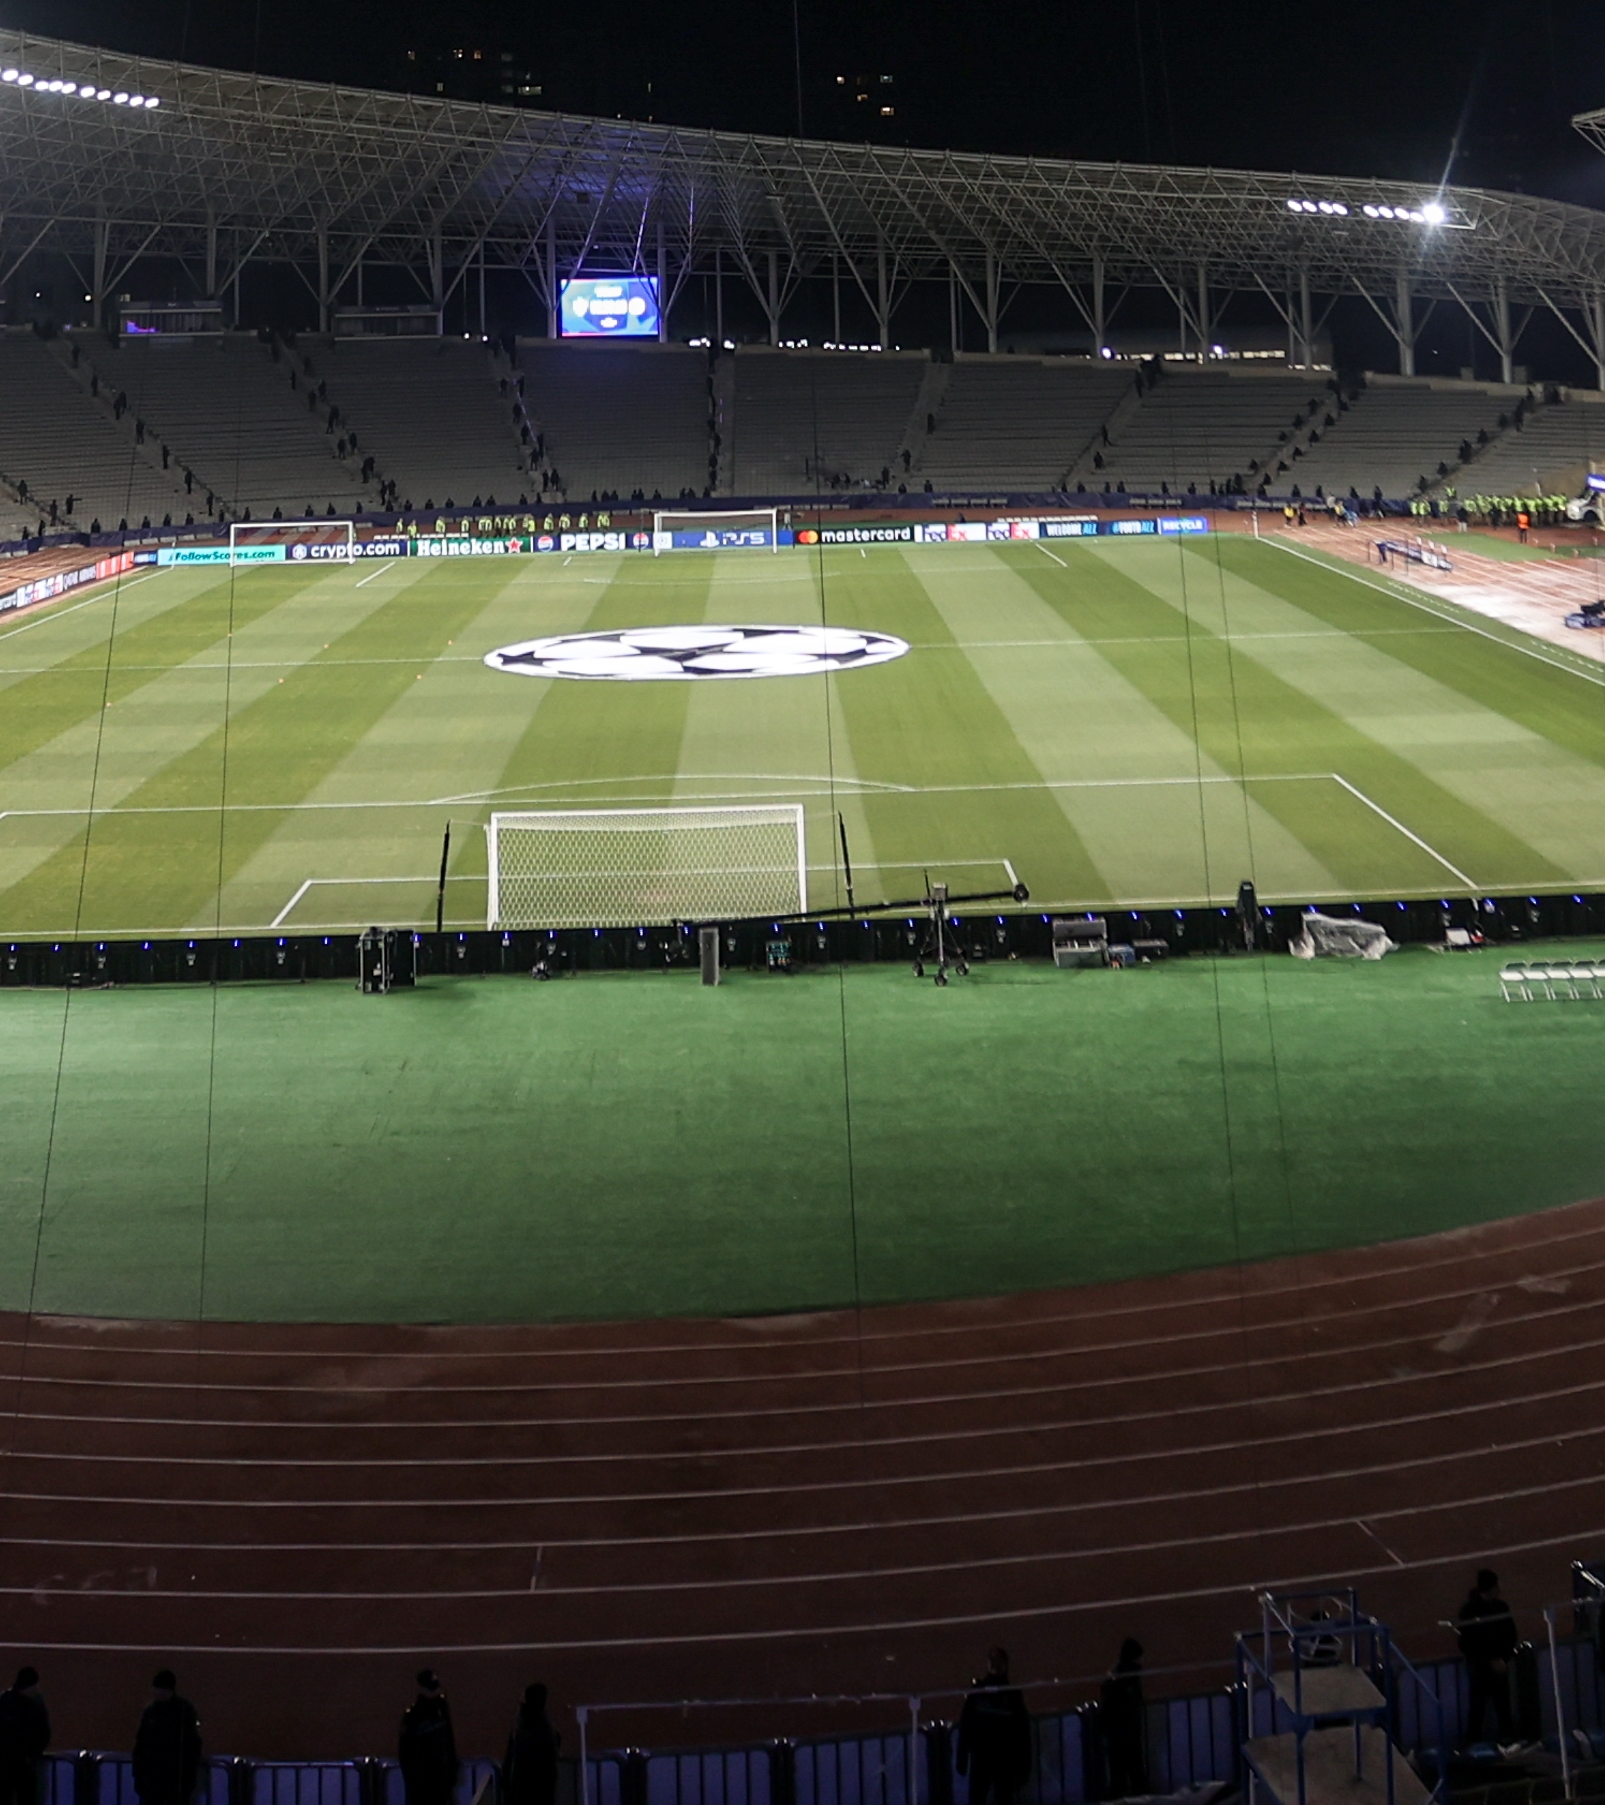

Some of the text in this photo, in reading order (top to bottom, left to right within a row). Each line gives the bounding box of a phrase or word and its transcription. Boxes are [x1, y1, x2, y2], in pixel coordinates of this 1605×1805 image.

[561, 533, 626, 551] PEPSI
[722, 531, 765, 546] PS5
[821, 527, 911, 543] mastercard
[417, 539, 505, 556] Heineken
[175, 551, 275, 561] FollowScoes.com
